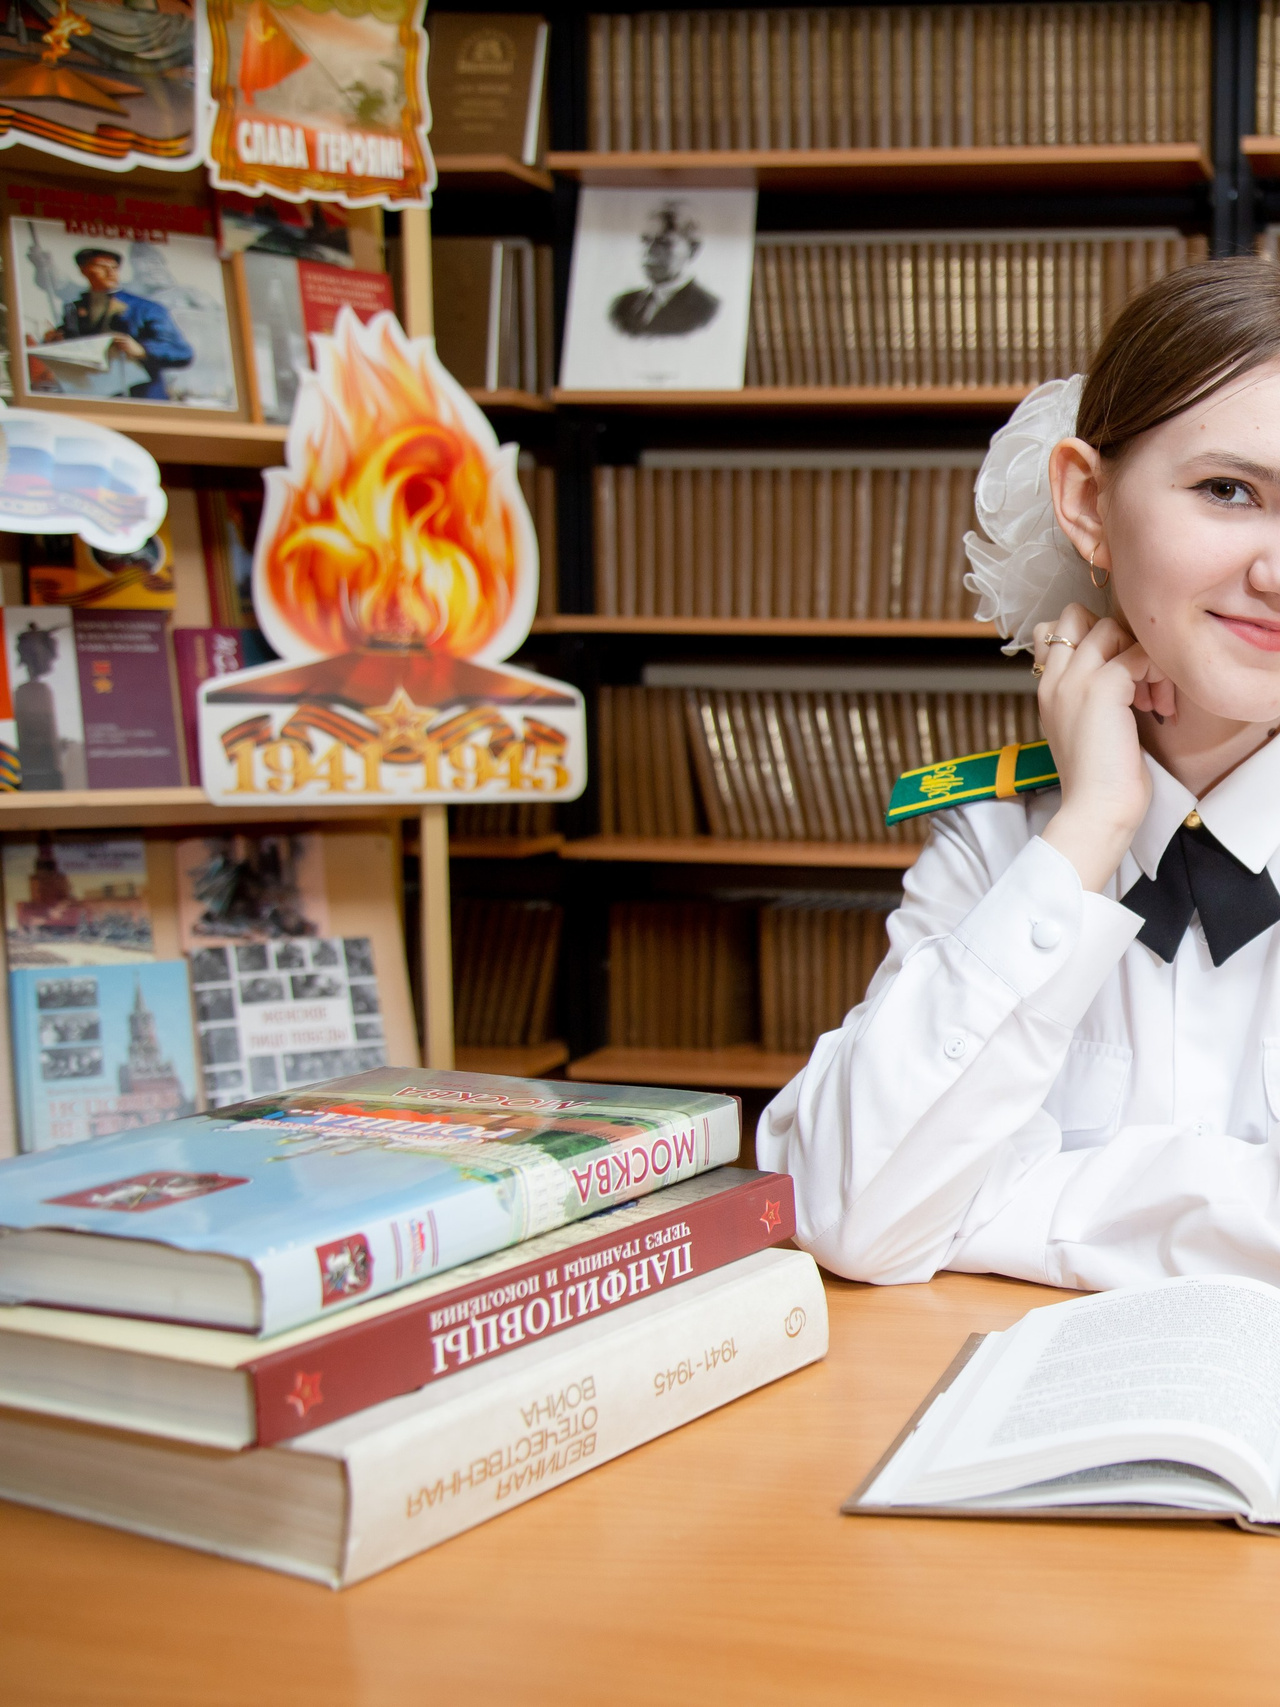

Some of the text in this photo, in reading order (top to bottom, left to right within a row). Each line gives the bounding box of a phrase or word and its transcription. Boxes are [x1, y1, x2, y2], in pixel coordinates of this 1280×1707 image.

[237, 120, 405, 181] СЛАВА ГЕРОЯМ!
[223, 738, 574, 793] 1941-1945
[392, 1086, 591, 1111] МОСКВА
[570, 1128, 696, 1205] МОСКВА
[429, 1222, 692, 1332] ЧЕРЕЗ ГРАНИЦЫ И ПОКОЛЕНИЯ
[431, 1241, 694, 1375] ПАНФИЛОВЦЫ
[653, 1337, 739, 1397] 1941-1945
[520, 1375, 597, 1428] ВОЙНА
[406, 1405, 598, 1518] ОТЕЧЕСТВЕННАЯ
[496, 1431, 598, 1501] ВЕЛИКАЯ
